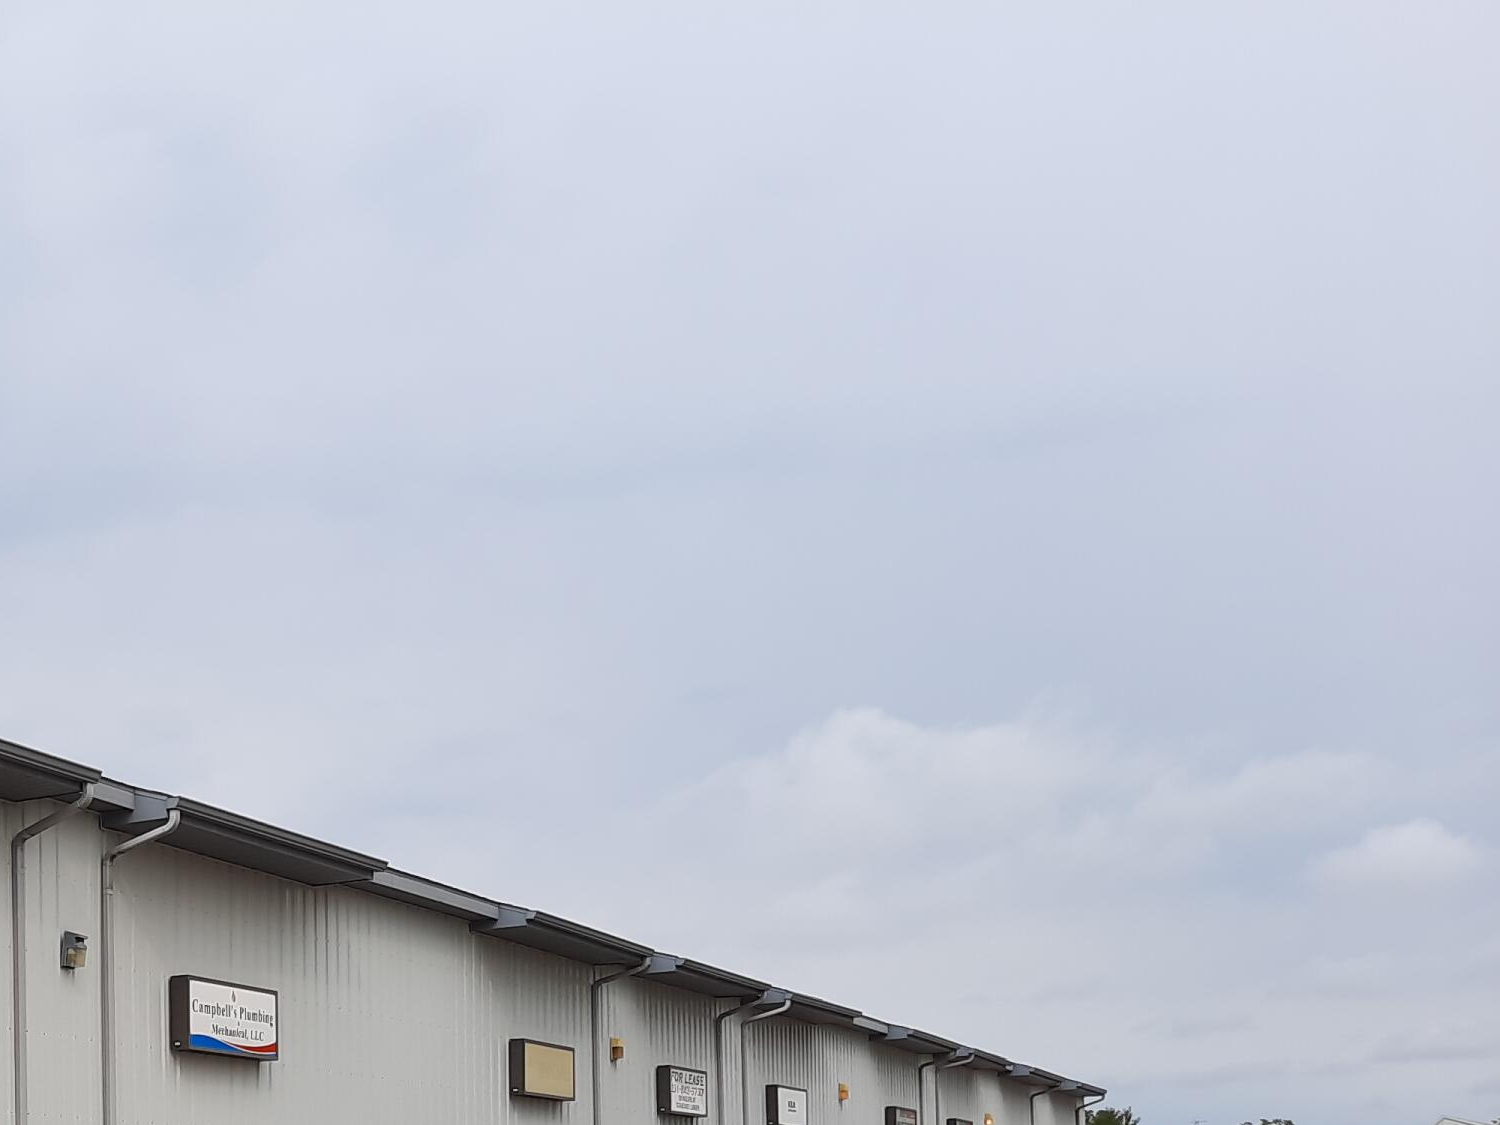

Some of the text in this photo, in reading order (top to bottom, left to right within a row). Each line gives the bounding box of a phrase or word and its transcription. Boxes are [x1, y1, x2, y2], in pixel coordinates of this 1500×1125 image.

[192, 998, 274, 1028] Campbell's Plumbing
[250, 1029, 265, 1042] LLC
[684, 1073, 705, 1087] LEASE
